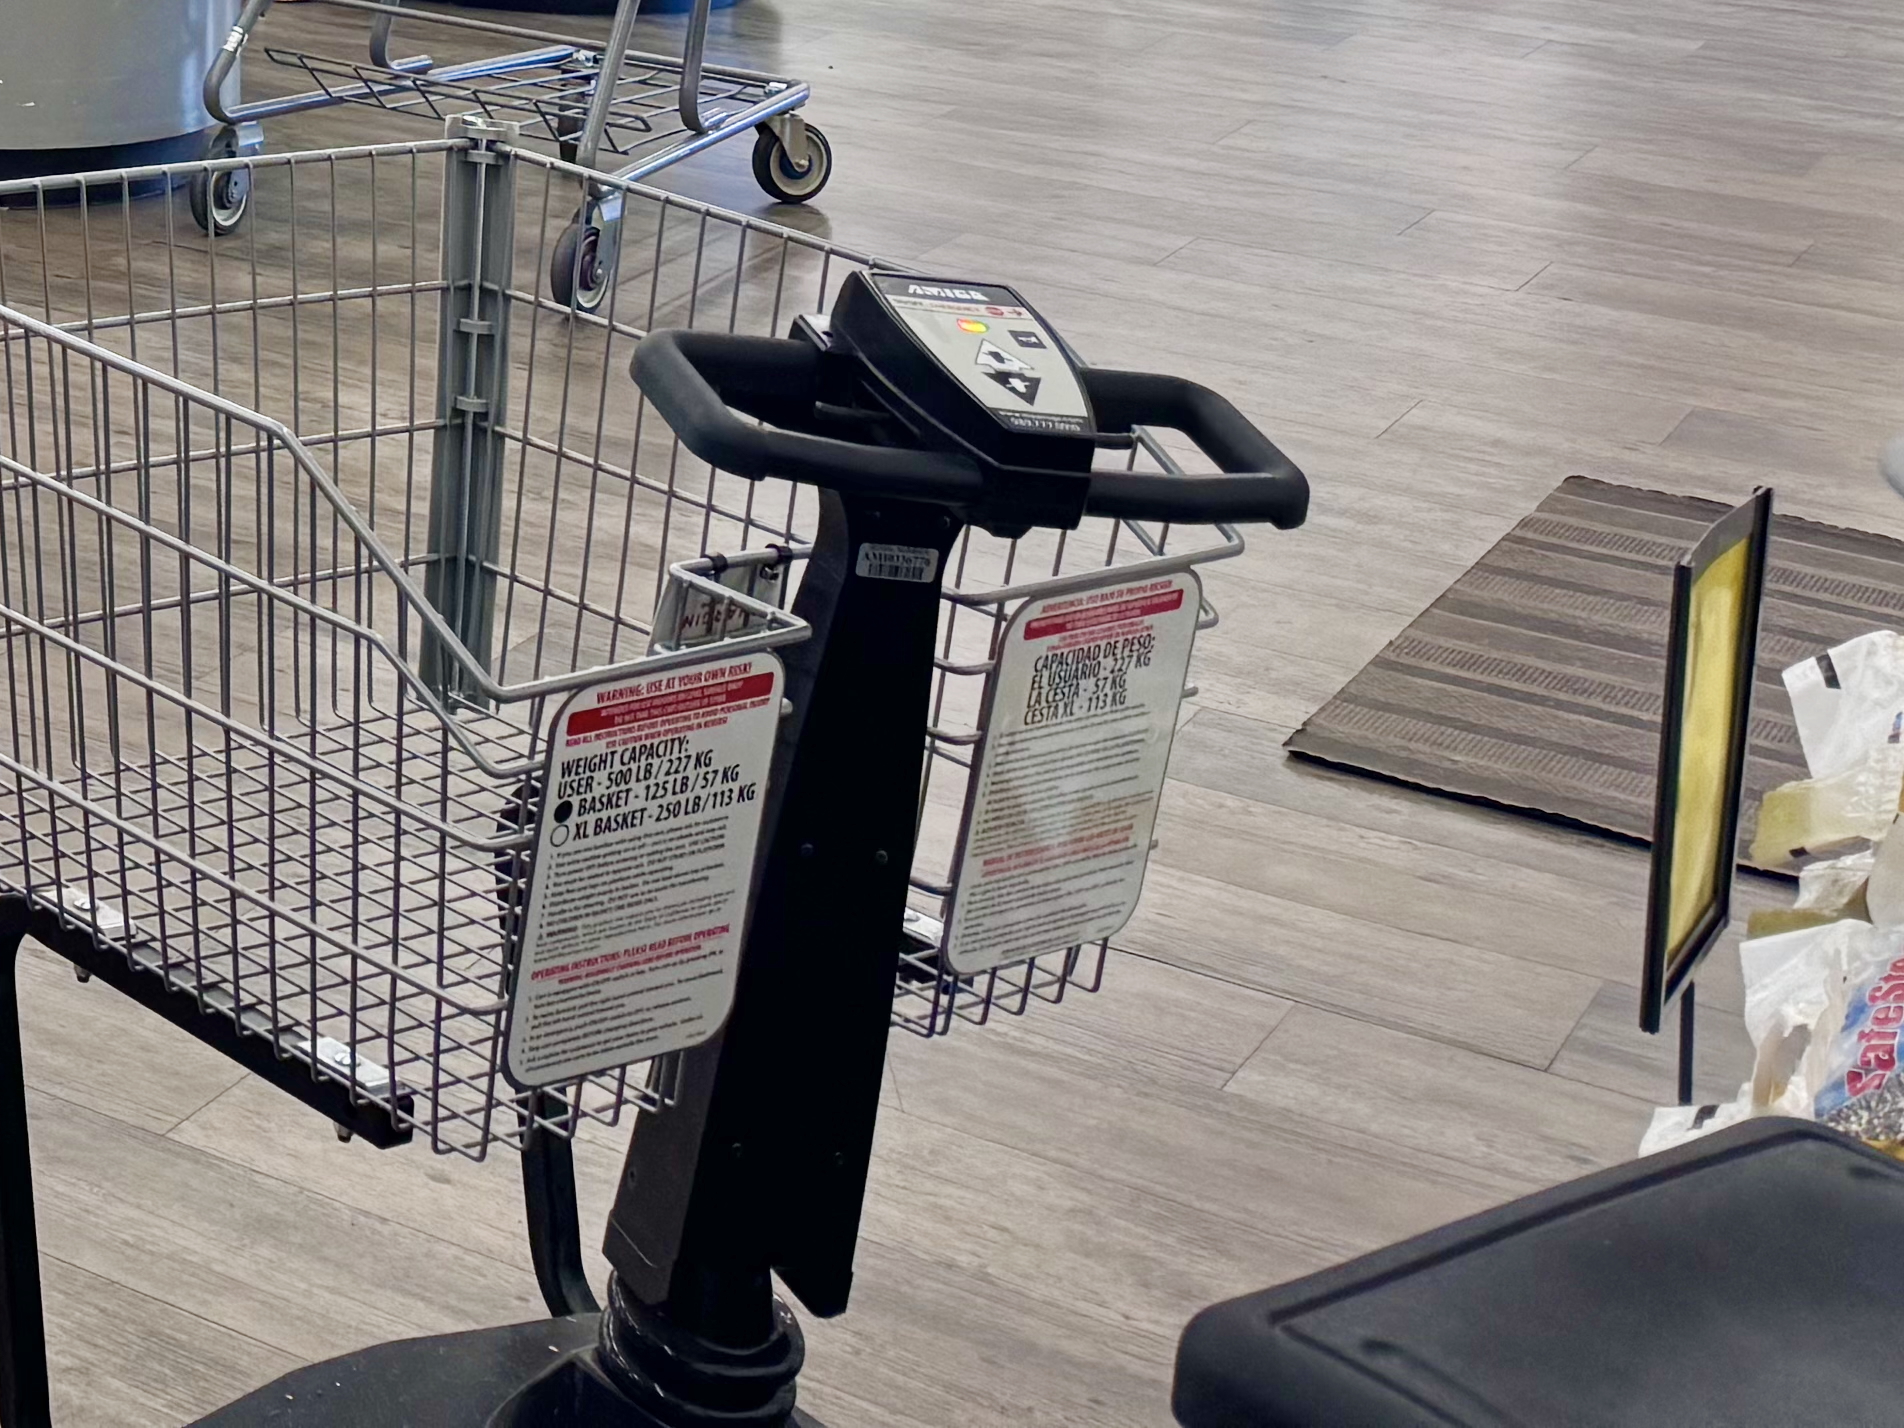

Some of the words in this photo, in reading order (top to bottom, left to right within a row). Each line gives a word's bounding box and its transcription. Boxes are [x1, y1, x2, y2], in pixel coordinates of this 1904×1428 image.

[1031, 675, 1044, 690] EL
[1048, 661, 1102, 687] USUARIO
[1110, 656, 1131, 675] 227
[1134, 650, 1151, 669] KG
[1034, 644, 1101, 672] CAPACIDAD
[1103, 640, 1119, 658] DE
[1121, 633, 1155, 654] PESO:
[596, 684, 645, 704] WARNING:
[646, 680, 664, 695] USE
[665, 676, 677, 690] AT
[678, 670, 704, 688] YOUR
[704, 666, 726, 684] OWN
[1027, 690, 1042, 709] LA
[1045, 682, 1079, 705] CESTA
[1094, 677, 1108, 694] 57
[1110, 673, 1126, 691] KG
[1024, 707, 1059, 726] CESTA
[1061, 700, 1076, 718] XL
[1087, 696, 1107, 714] 113
[1110, 689, 1126, 706] KG
[558, 776, 593, 800] USER
[606, 768, 632, 789] 500
[635, 763, 652, 781] LB
[665, 755, 690, 776] 227
[694, 749, 714, 770] KG
[561, 752, 617, 779] WEIGHT
[620, 735, 689, 764] CAPACITY:
[578, 788, 633, 817] BASKET
[644, 781, 669, 802] 125
[672, 776, 689, 794] LB
[702, 770, 719, 789] 57
[721, 763, 740, 785] KG
[572, 820, 590, 842] XL
[593, 809, 647, 837] BASKET
[655, 802, 682, 822] 250
[737, 782, 757, 804] KG
[1845, 946, 1904, 1098] SafeSt
